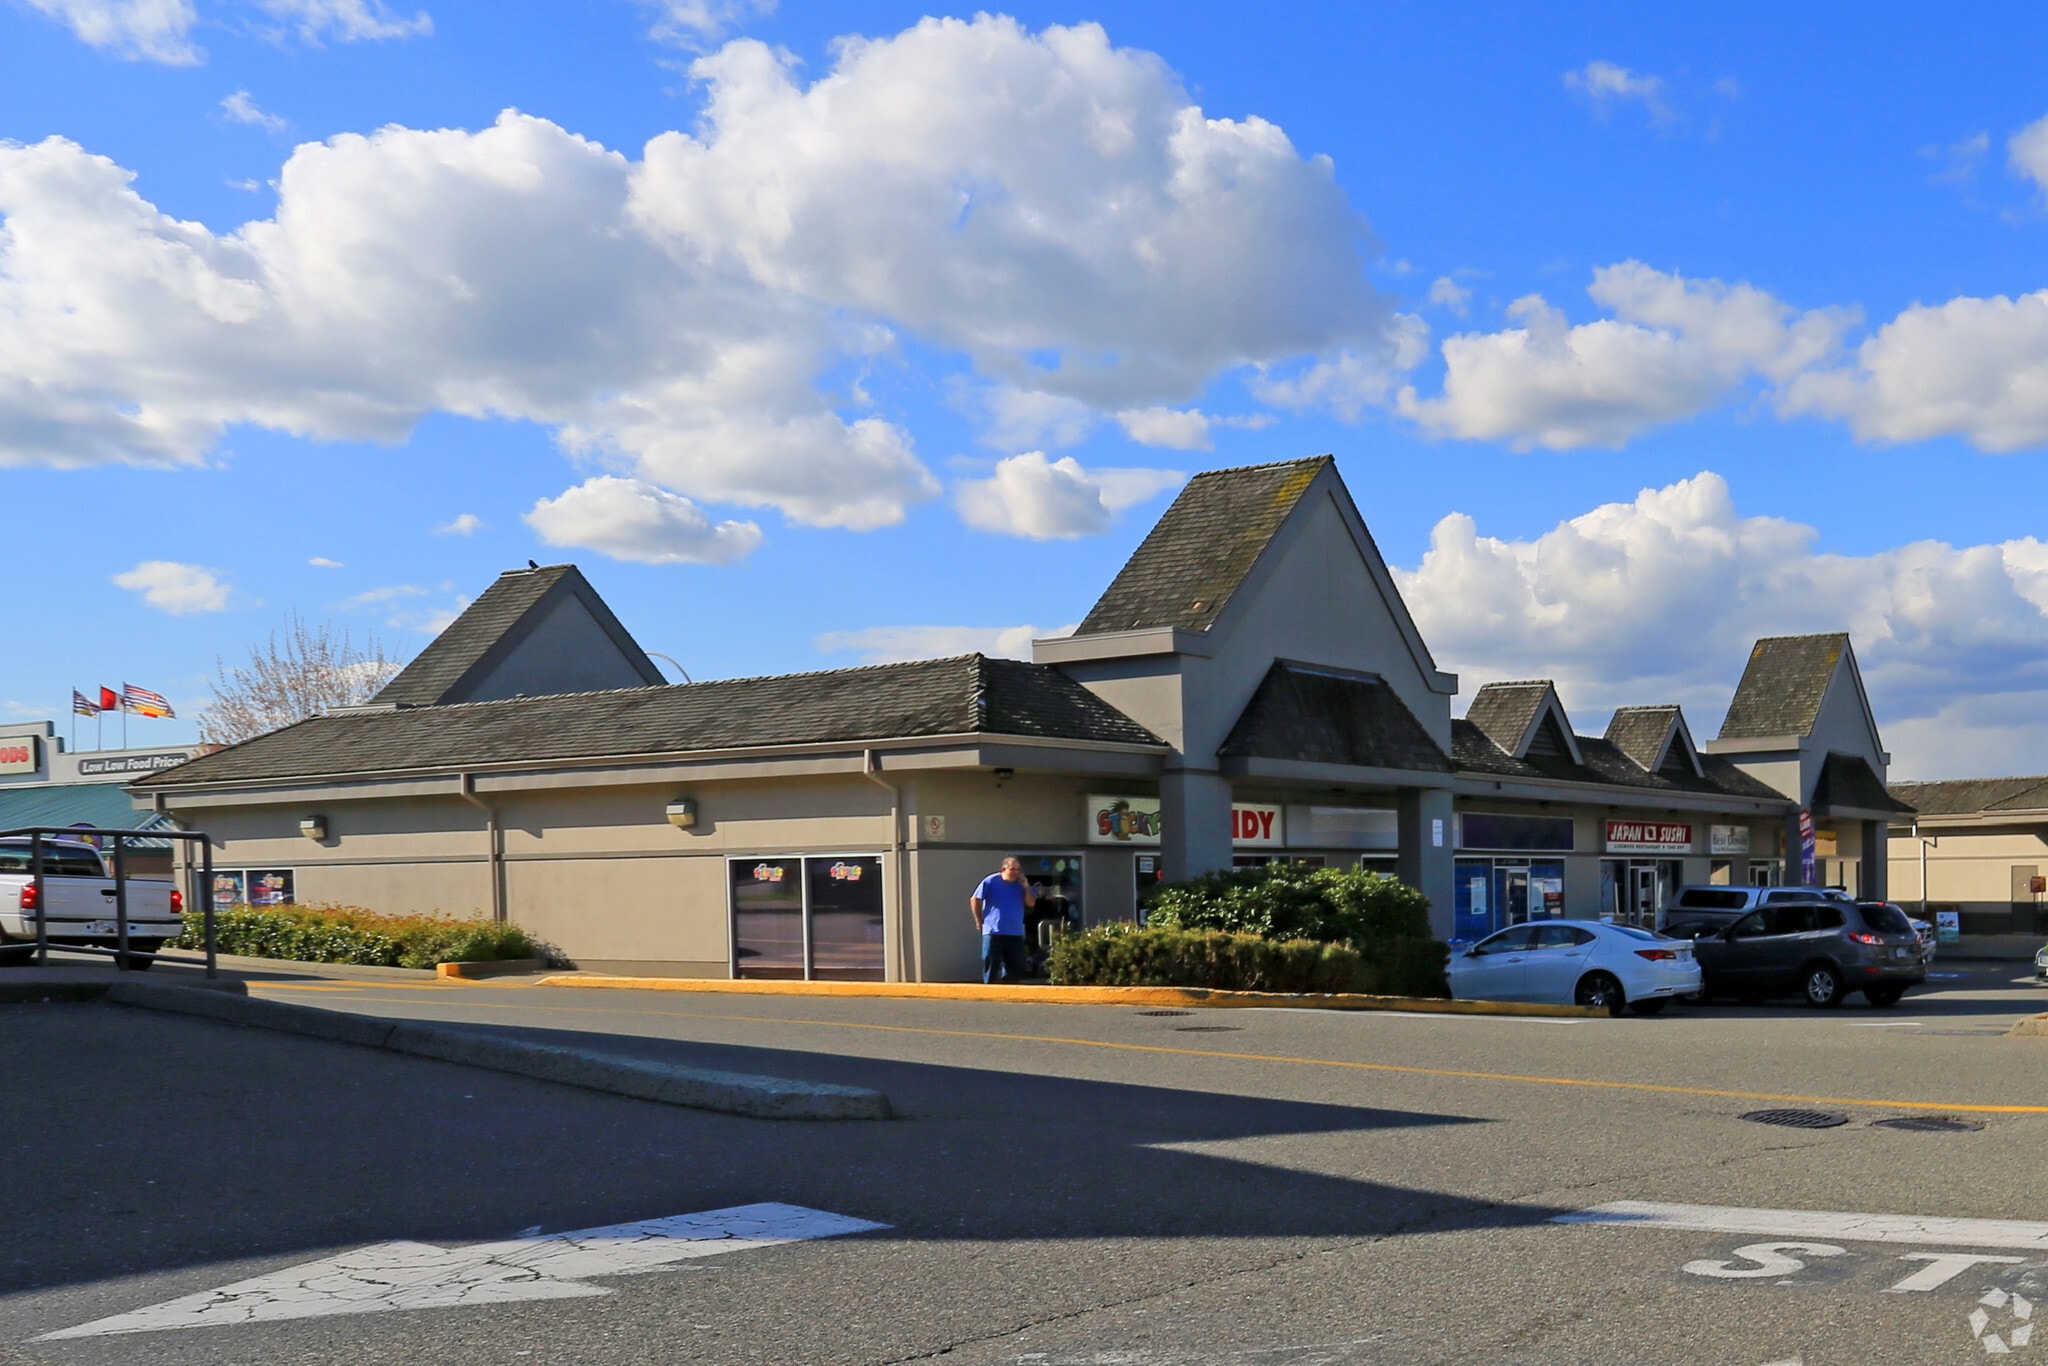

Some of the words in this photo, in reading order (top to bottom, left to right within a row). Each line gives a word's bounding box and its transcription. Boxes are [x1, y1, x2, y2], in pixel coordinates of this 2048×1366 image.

[82, 762, 103, 773] Low
[105, 760, 126, 771] Low
[127, 757, 153, 769] Food
[153, 756, 186, 769] Prices
[1610, 824, 1642, 841] JAPAN
[1660, 826, 1686, 843] SUSHI
